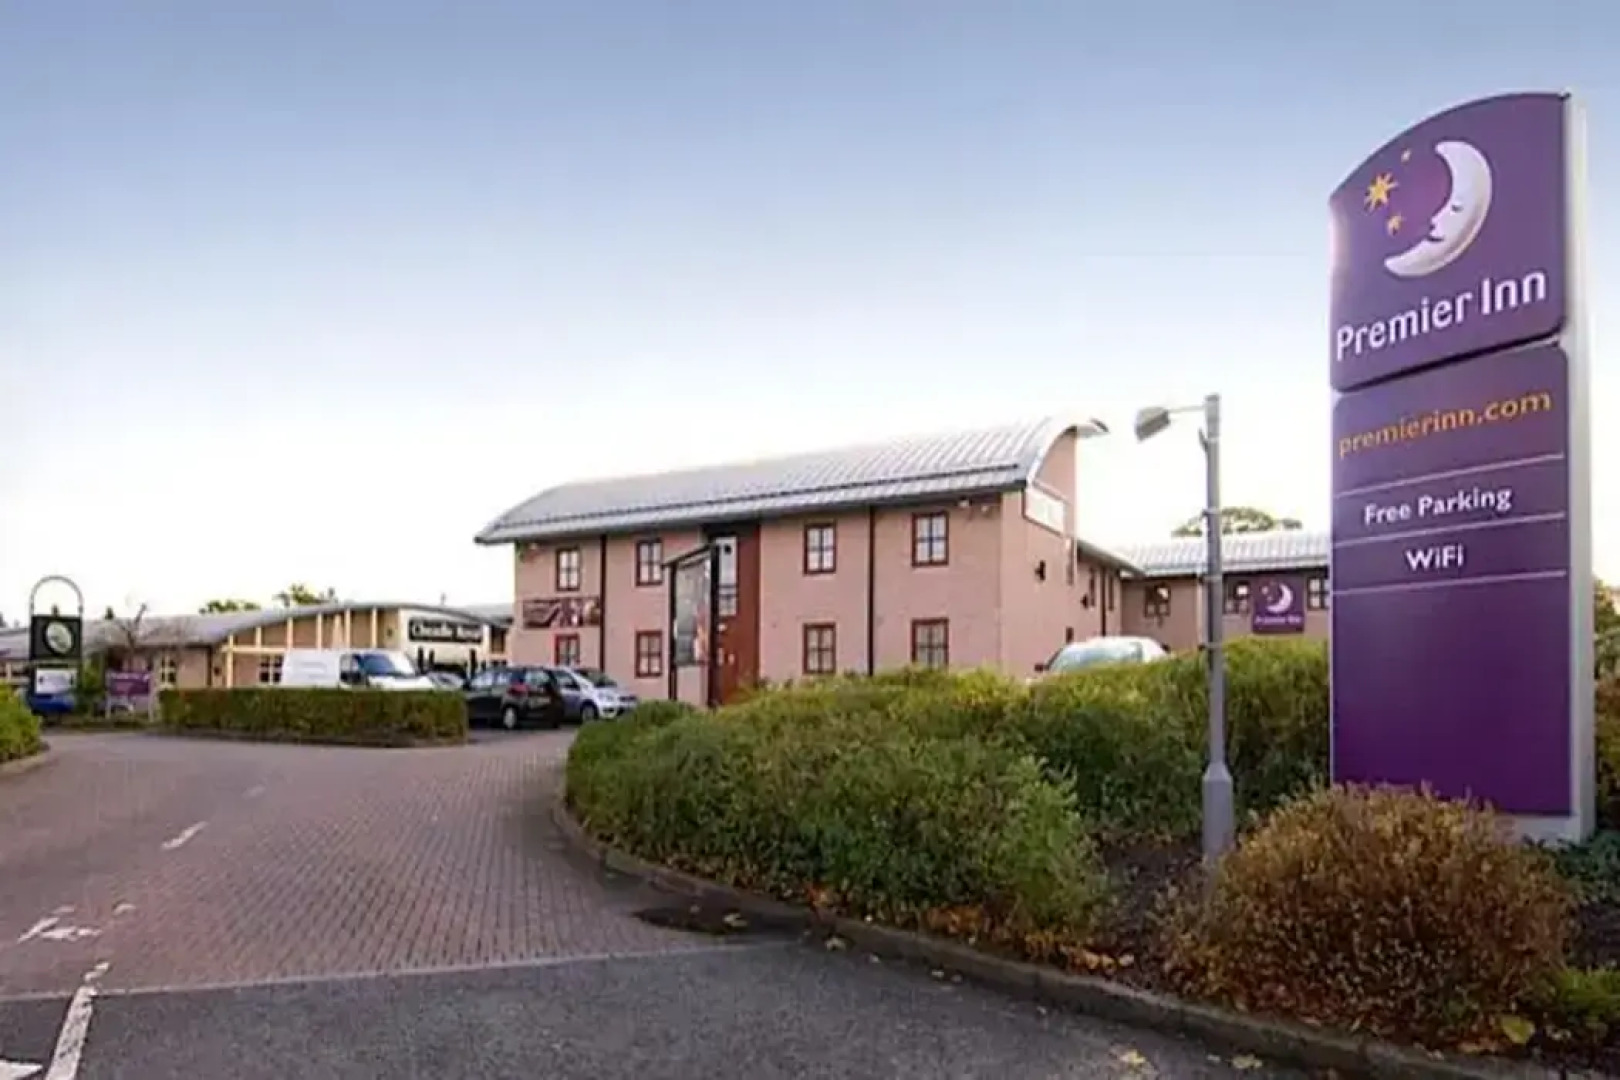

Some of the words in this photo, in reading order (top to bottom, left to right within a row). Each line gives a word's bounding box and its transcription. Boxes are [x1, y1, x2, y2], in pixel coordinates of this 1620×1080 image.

[1336, 296, 1472, 361] Premier
[1481, 272, 1546, 315] Inn
[1338, 392, 1552, 459] premierinn.com
[1364, 503, 1411, 526] Free
[1418, 486, 1512, 515] Parking
[1406, 543, 1464, 571] WiFi
